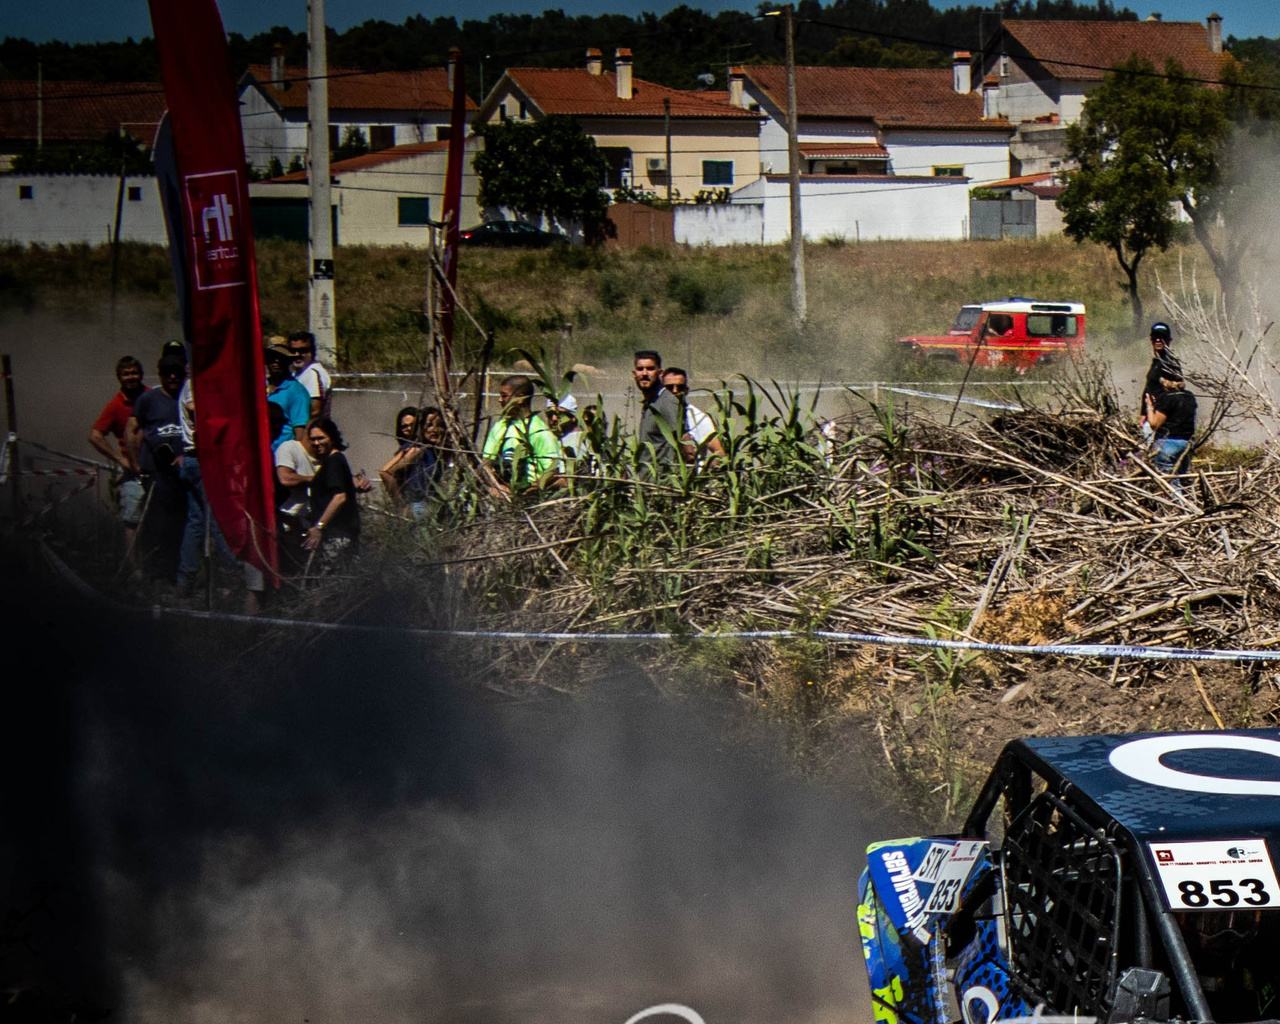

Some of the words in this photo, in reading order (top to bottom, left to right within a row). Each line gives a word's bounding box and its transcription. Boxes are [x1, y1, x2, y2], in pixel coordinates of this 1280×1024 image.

[918, 846, 950, 881] STK
[929, 879, 962, 912] 853
[1177, 878, 1271, 908] 853
